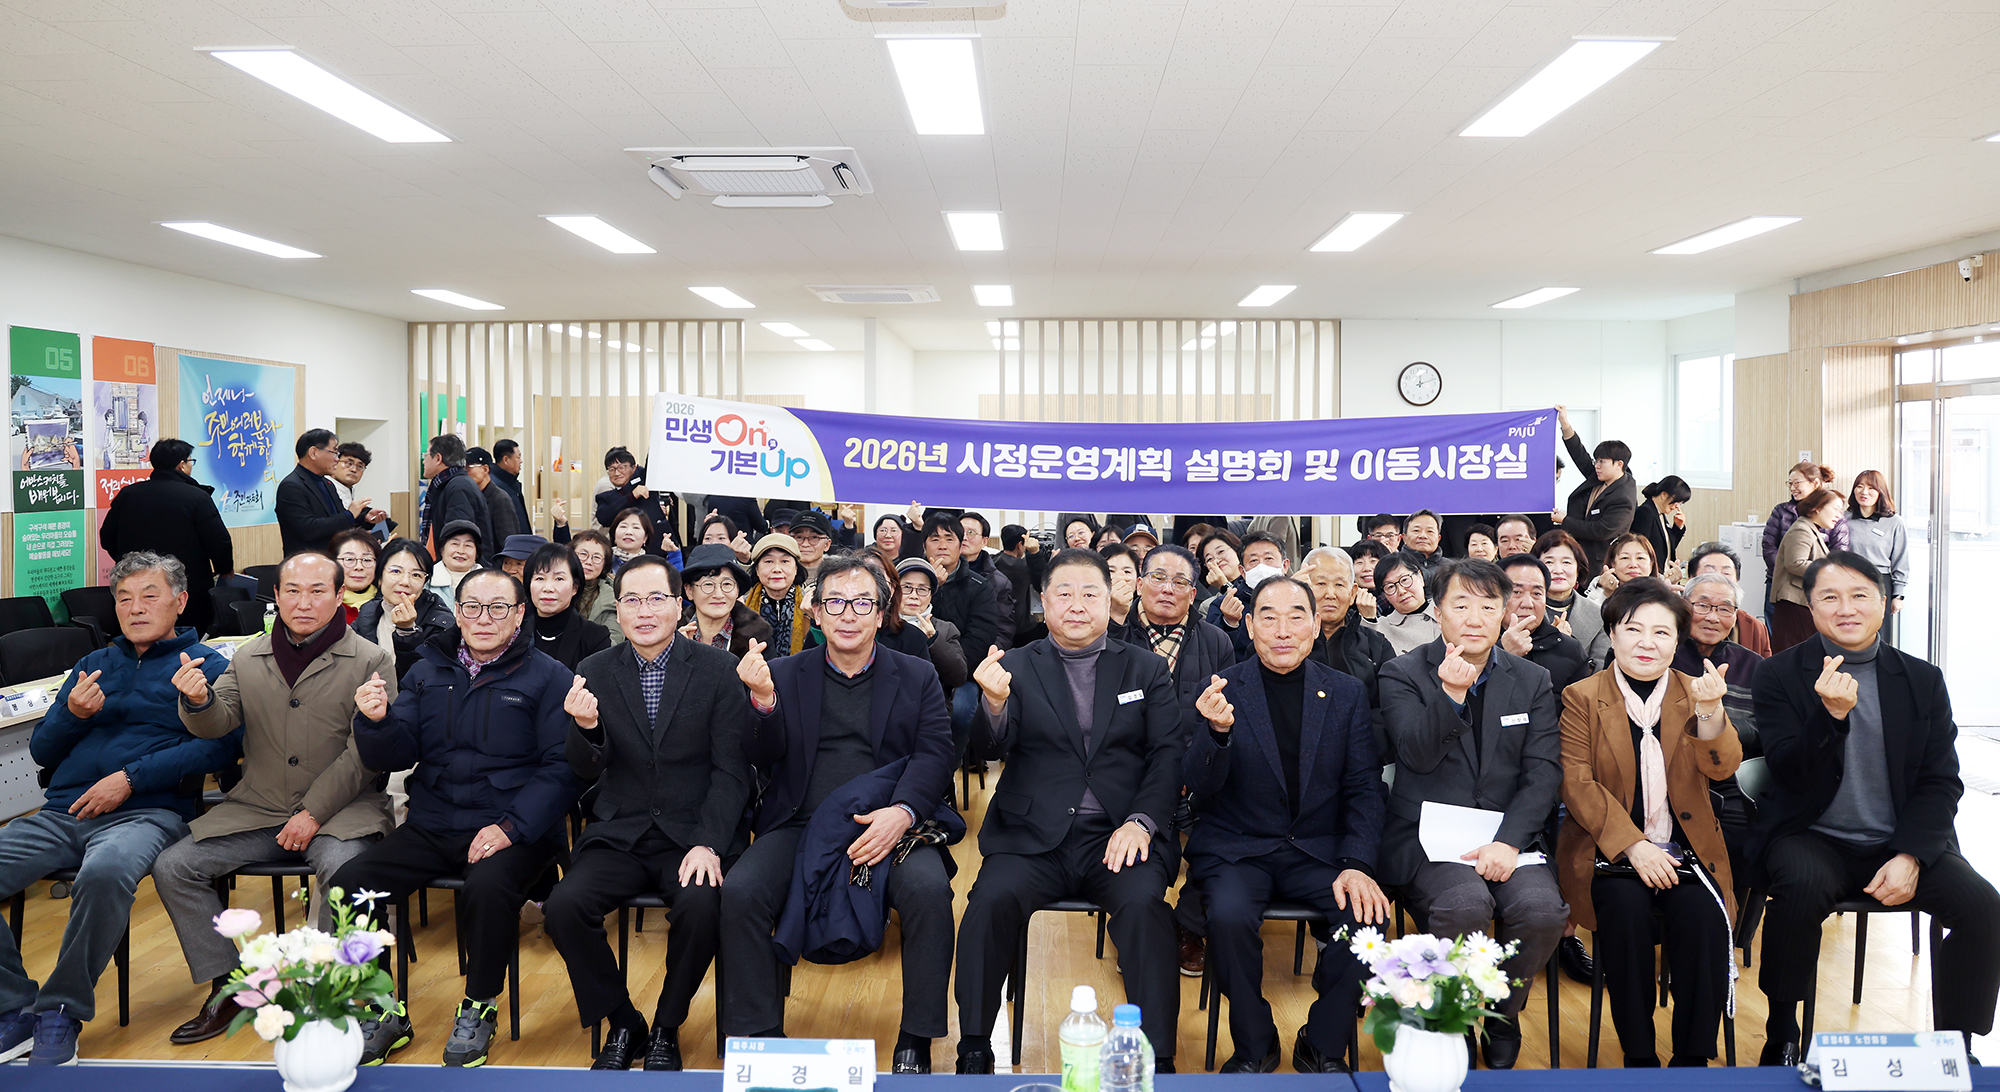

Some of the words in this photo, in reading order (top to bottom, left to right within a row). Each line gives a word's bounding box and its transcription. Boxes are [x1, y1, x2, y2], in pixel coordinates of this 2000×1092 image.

[45, 347, 73, 371] 05
[124, 355, 149, 376] 06
[202, 374, 255, 407] 언제나
[665, 401, 695, 416] 2026
[665, 417, 712, 444] 민생
[714, 413, 768, 447] On
[1508, 426, 1536, 439] PAJU
[709, 449, 759, 476] 기본
[759, 447, 811, 488] Up
[843, 437, 949, 474] 2026년
[956, 442, 1172, 482] 시정운영계획
[1184, 449, 1293, 482] 설명회
[1303, 448, 1340, 482] 및
[1350, 442, 1529, 482] 이동시장실
[732, 1041, 765, 1051] 파주시장
[736, 1064, 752, 1083] 김
[792, 1065, 807, 1085] 경
[848, 1066, 863, 1085] 일
[1831, 1058, 1848, 1077] 김
[1887, 1058, 1903, 1077] 성
[1941, 1058, 1959, 1077] 배
